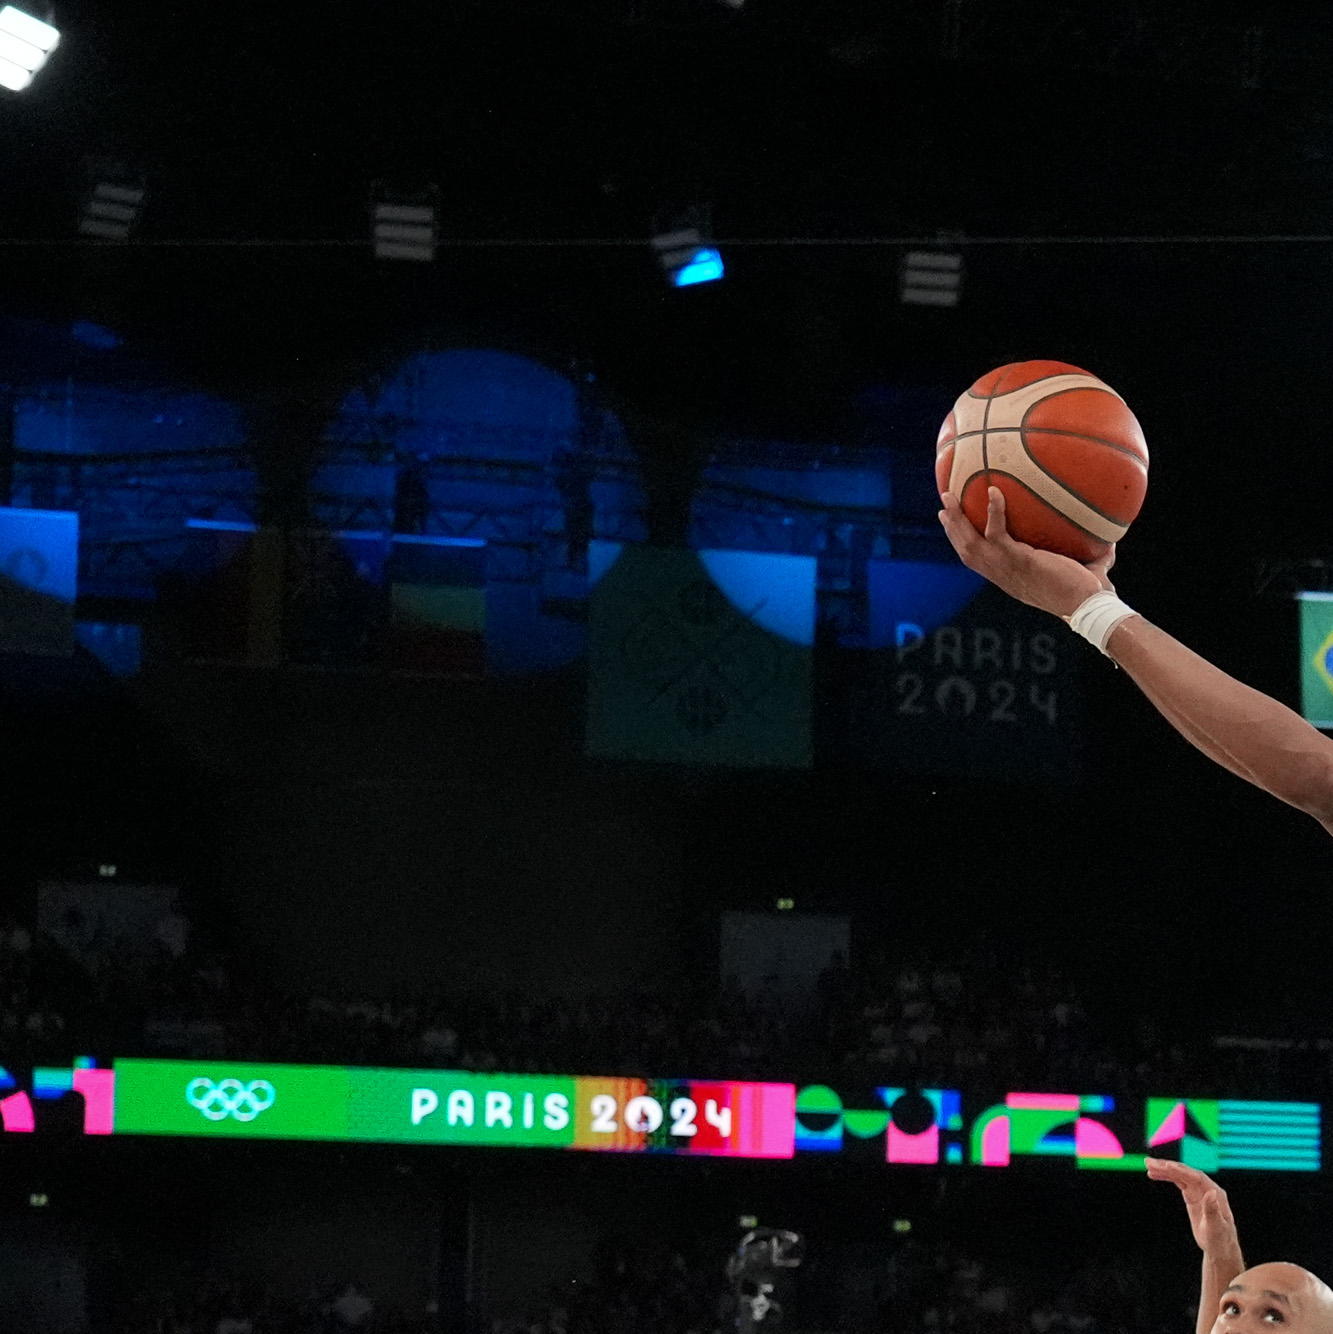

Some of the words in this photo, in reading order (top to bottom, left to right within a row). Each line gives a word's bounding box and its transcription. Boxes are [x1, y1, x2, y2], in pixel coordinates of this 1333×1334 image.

[895, 620, 1058, 674] PARIS
[898, 672, 1058, 725] 2024
[410, 1086, 570, 1132] PARIS
[589, 1093, 732, 1138] 2024
